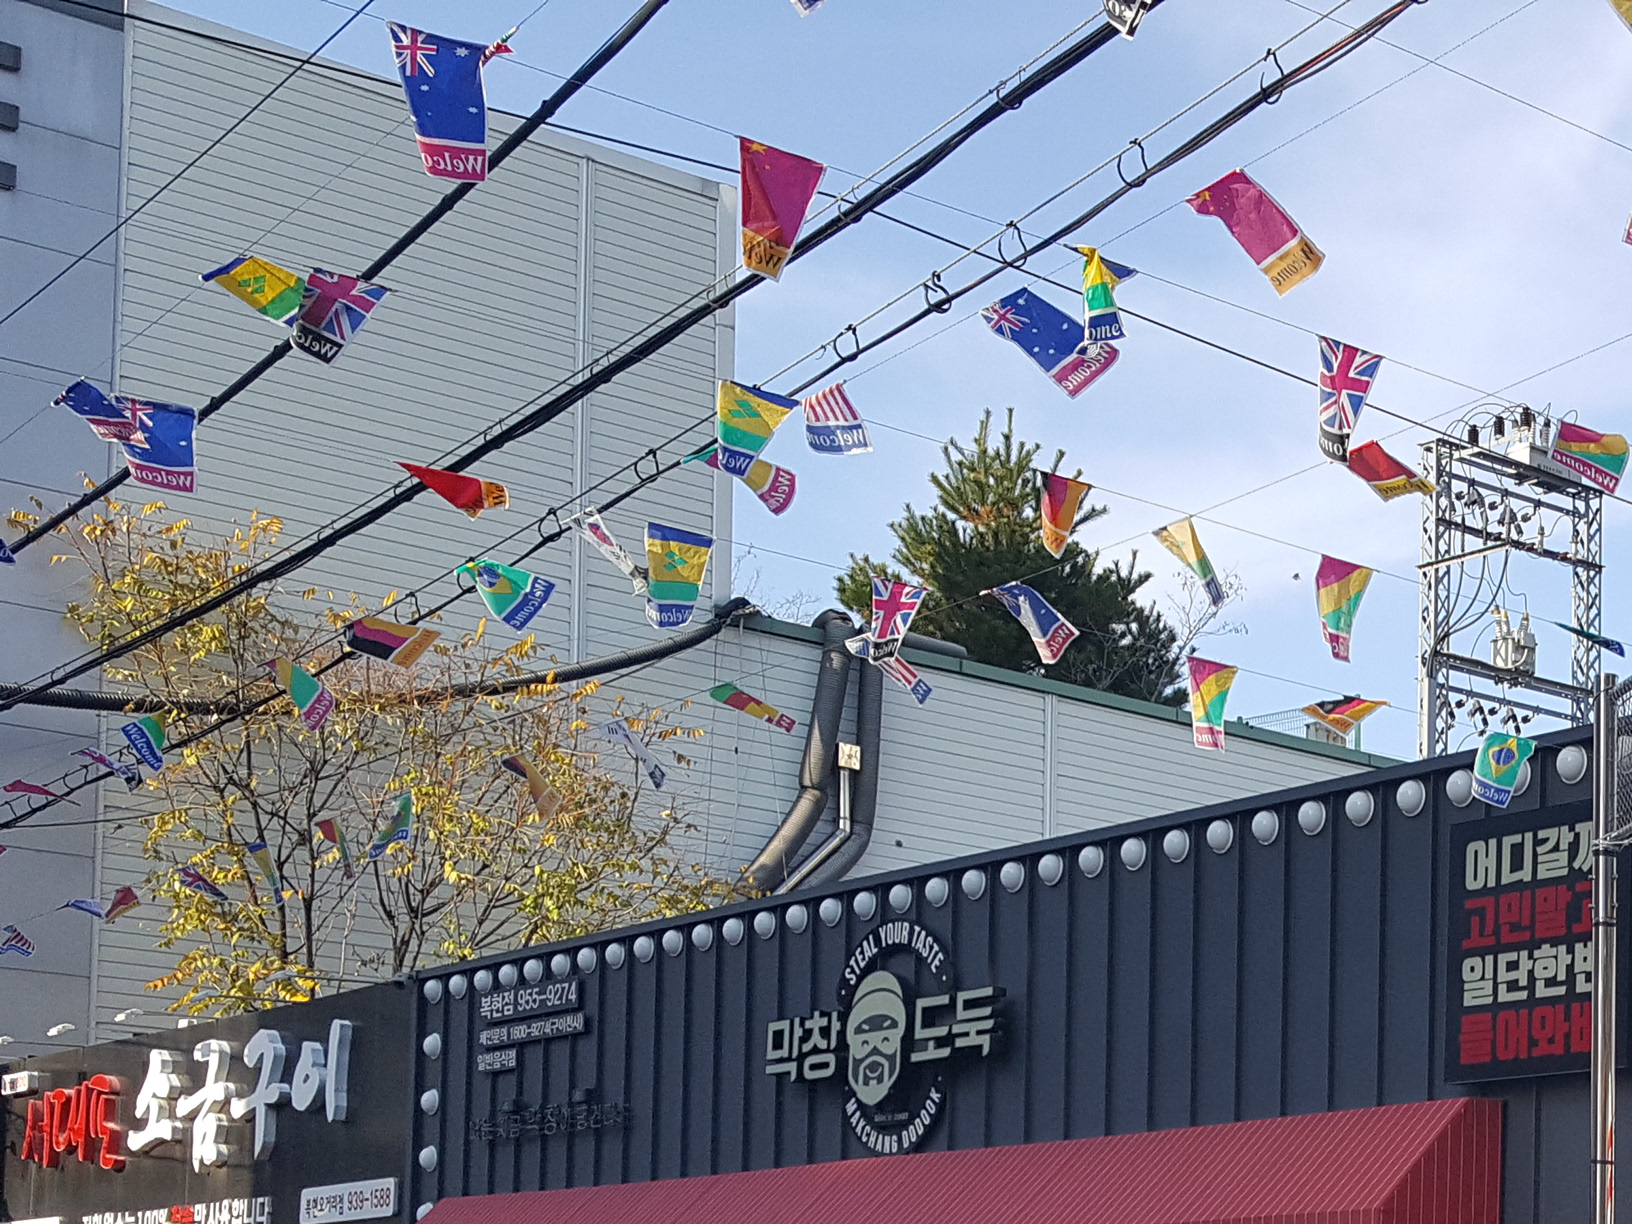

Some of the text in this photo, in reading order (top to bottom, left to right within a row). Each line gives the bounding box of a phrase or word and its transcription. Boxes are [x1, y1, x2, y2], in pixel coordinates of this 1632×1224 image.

[845, 921, 944, 985] STEAL YOUR TASTE
[479, 981, 577, 1019] 복현점 955-9274
[765, 986, 996, 1082] 막창 도둑
[127, 1018, 353, 1173] 소금구이
[845, 1087, 942, 1154] MAKCHANG DODOOK
[347, 1186, 392, 1212] 939-1588
